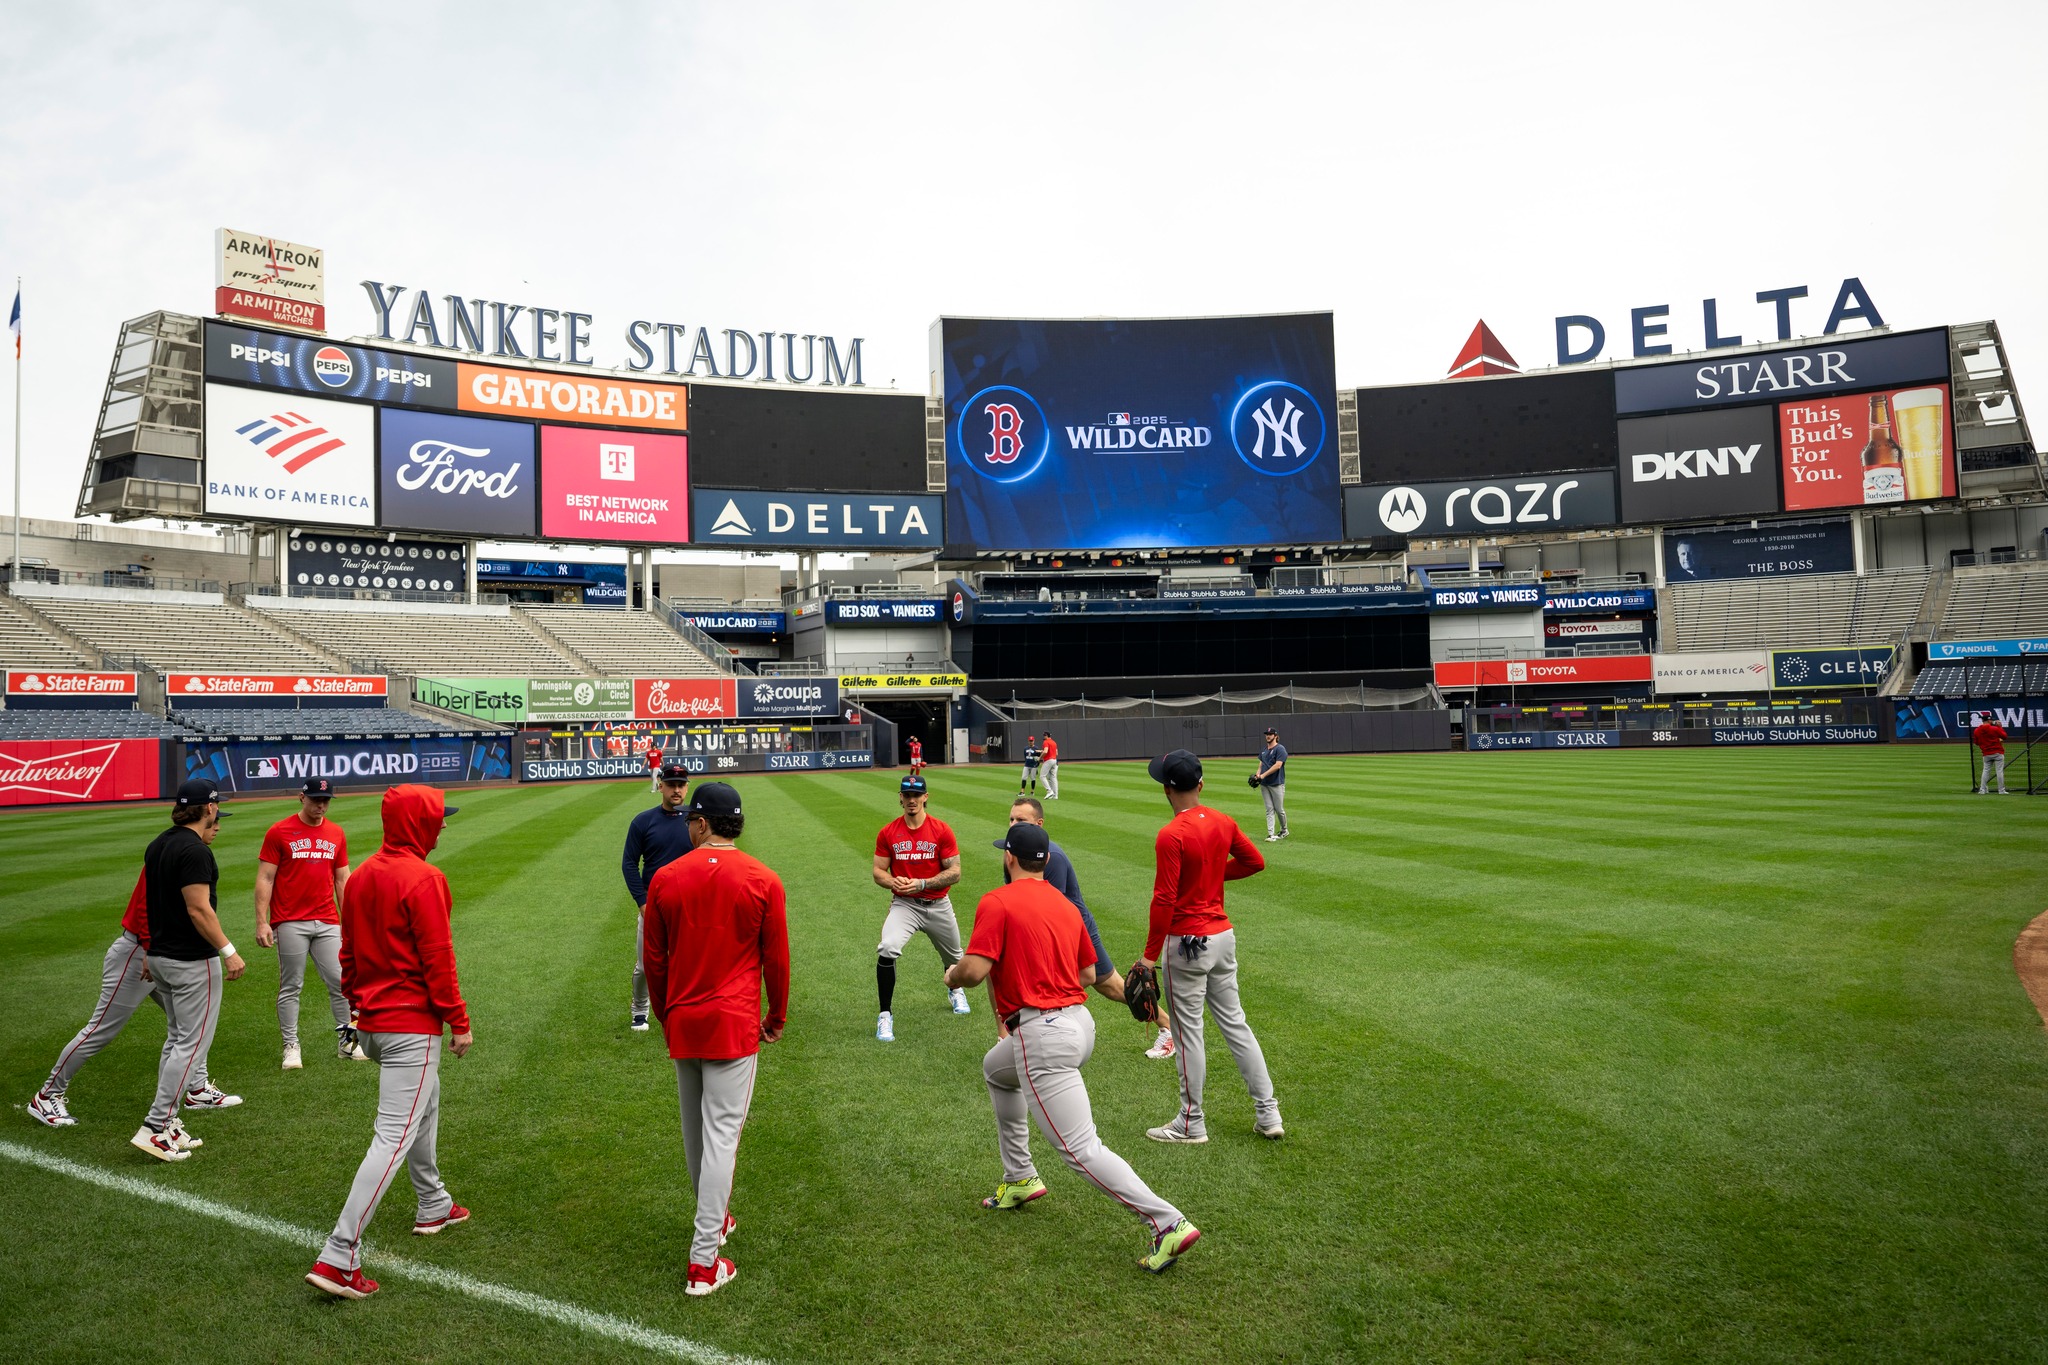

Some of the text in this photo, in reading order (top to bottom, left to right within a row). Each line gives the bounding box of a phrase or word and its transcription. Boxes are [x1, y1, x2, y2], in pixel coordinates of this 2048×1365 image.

[226, 238, 319, 269] ARMITRON
[231, 293, 315, 318] ARMITRON
[273, 311, 314, 326] WATCHES
[1555, 276, 1885, 365] DELTA
[359, 279, 865, 386] YANKEE STADIUM
[230, 342, 290, 368] PEPSI
[316, 360, 350, 374] PEPSI
[376, 366, 432, 388] PEPSI
[1695, 350, 1856, 400] STARR
[472, 372, 676, 420] GATORADE
[1132, 415, 1168, 425] 2025
[1786, 404, 1841, 426] This
[1788, 422, 1854, 445] Bud's
[1790, 446, 1830, 464] For
[396, 440, 521, 499] Ford
[1632, 444, 1762, 483] DKNY
[1790, 466, 1842, 484] You.
[210, 482, 370, 509] BANK OF AMERICA
[1865, 490, 1903, 500] Budweiser
[566, 494, 669, 512] BEST NETWORK
[1446, 480, 1579, 527] razr
[579, 509, 657, 525] IN AMERICA
[768, 502, 929, 535] DELTA
[1769, 533, 1817, 541] STEINBRENNER
[1764, 544, 1794, 552] 1930-2010
[341, 558, 414, 574] New York Yankees
[1748, 560, 1814, 572] THE BOSS
[1436, 592, 1456, 605] RED
[1458, 591, 1478, 604] SOX
[1492, 589, 1538, 602] YANKEES
[839, 605, 859, 618] RED
[860, 605, 880, 618] SOX
[892, 604, 935, 617] YANKEES
[1560, 624, 1598, 634] TOYOTA
[1956, 645, 1998, 654] FANDUEL
[1530, 666, 1578, 676] TOYOTA
[1658, 669, 1684, 677] BANK
[1700, 666, 1745, 676] AMERICA
[1820, 660, 1884, 674] CLEAR
[532, 680, 572, 692] Morningside
[842, 676, 964, 687] Gillette Gillette Gillette
[474, 690, 523, 710] Eats
[610, 690, 630, 700] Circle
[648, 687, 722, 716] Chick-fil-A
[775, 686, 822, 703] coupa
[771, 706, 796, 714] Margins
[1498, 736, 1532, 744] CLEAR
[1556, 732, 1608, 746] STARR
[1652, 731, 1672, 742] 385
[1714, 728, 1877, 742] StubHub StubHub StubHub
[421, 756, 460, 768] 2025
[718, 756, 734, 768] 399
[770, 755, 810, 768] STARR
[840, 754, 870, 762] CLEAR
[528, 762, 582, 779] StubHub
[586, 760, 642, 776] StubHub
